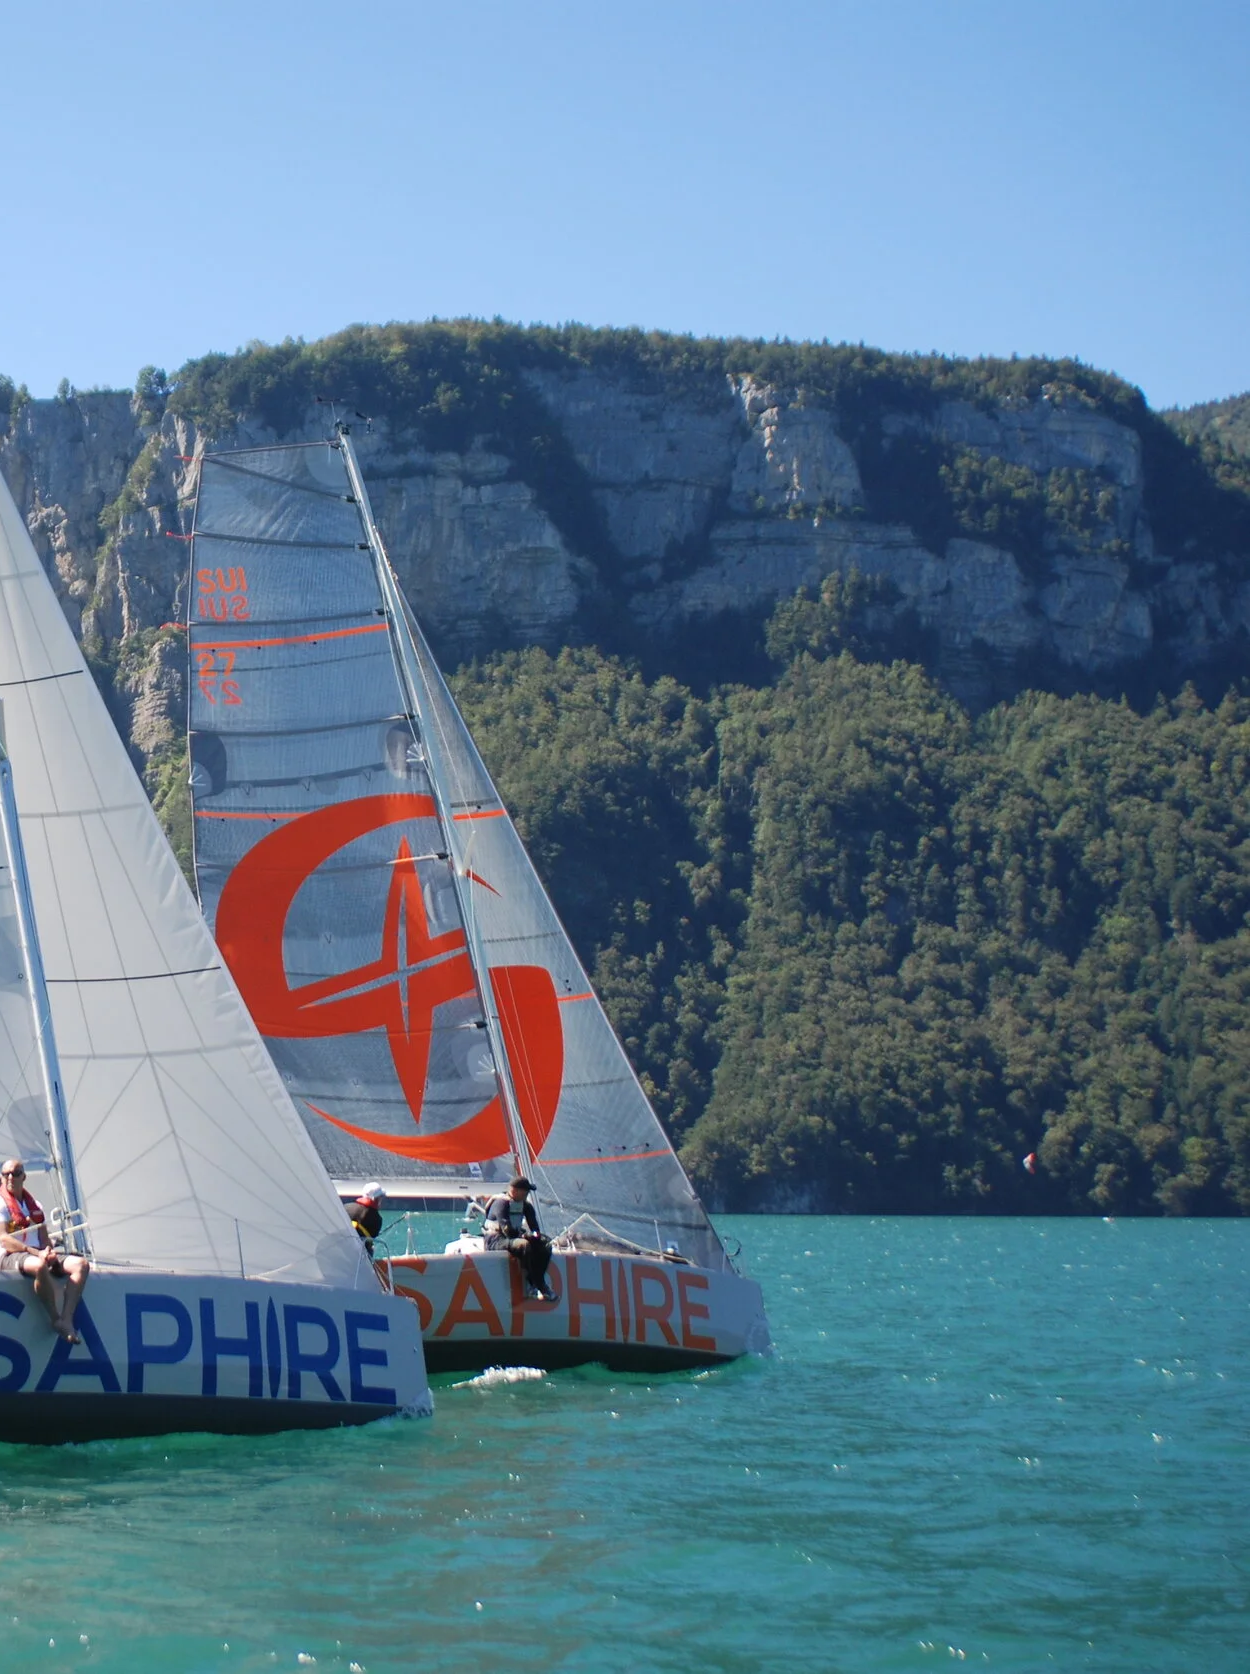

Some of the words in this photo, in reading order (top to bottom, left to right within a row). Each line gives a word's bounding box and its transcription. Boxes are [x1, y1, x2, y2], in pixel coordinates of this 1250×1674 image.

[197, 566, 248, 594] SUI
[196, 651, 236, 677] 27
[376, 1253, 716, 1351] SAPHIRE
